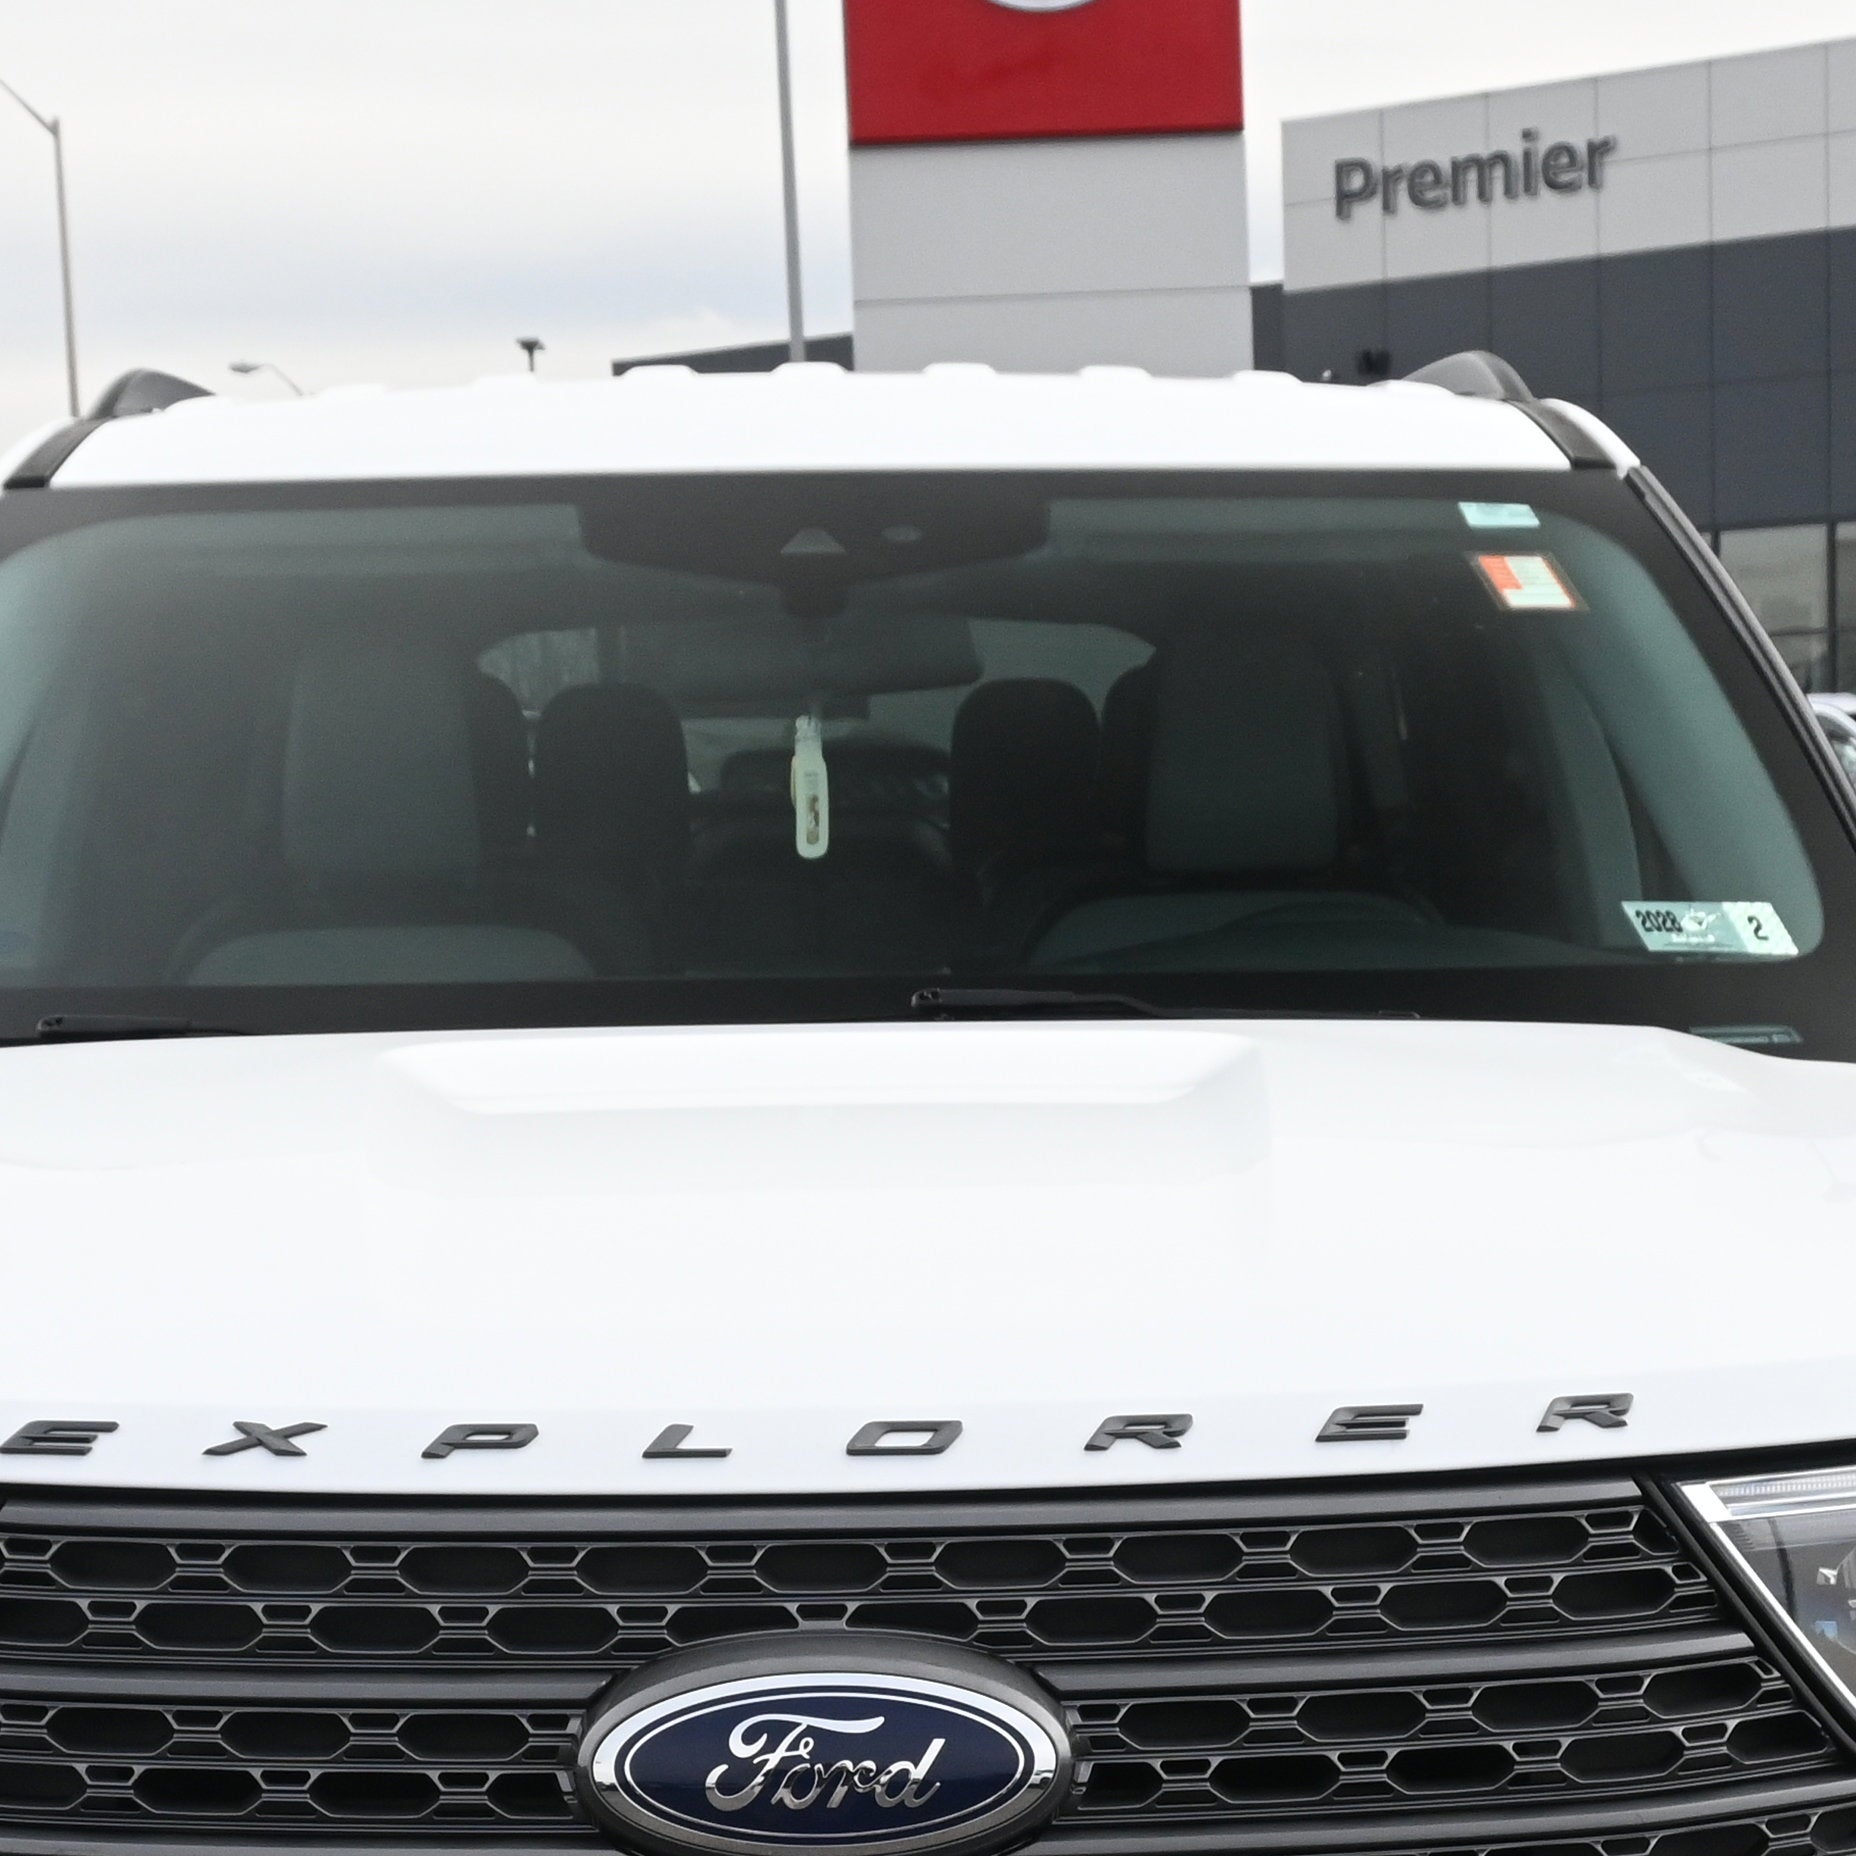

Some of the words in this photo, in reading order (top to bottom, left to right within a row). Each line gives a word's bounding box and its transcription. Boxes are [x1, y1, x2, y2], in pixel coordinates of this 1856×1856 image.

[1334, 127, 1617, 222] Premier
[1746, 914, 1770, 942] 2
[705, 1713, 947, 1813] Ford
